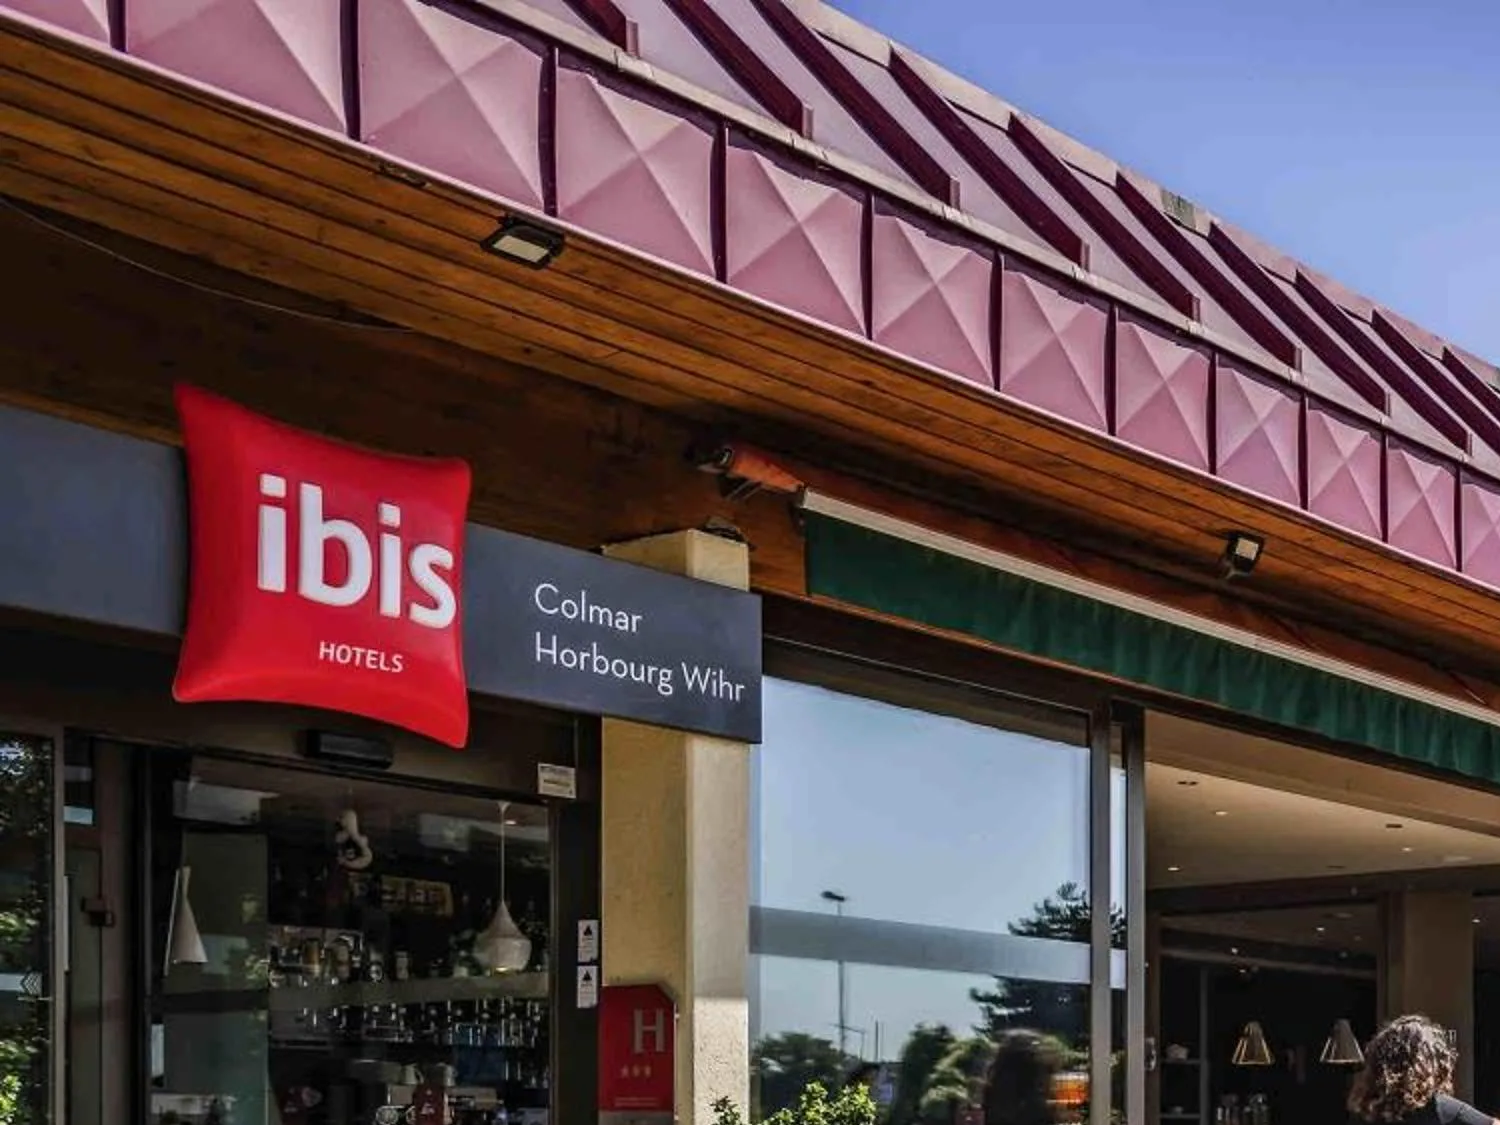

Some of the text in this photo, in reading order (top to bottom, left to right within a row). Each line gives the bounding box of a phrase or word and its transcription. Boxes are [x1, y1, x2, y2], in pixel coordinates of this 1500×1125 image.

[257, 472, 457, 629] ibis
[535, 583, 642, 632] Colmar
[319, 640, 404, 673] HOTELS
[535, 631, 746, 701] Horbourg Wihr
[633, 1008, 666, 1054] H
